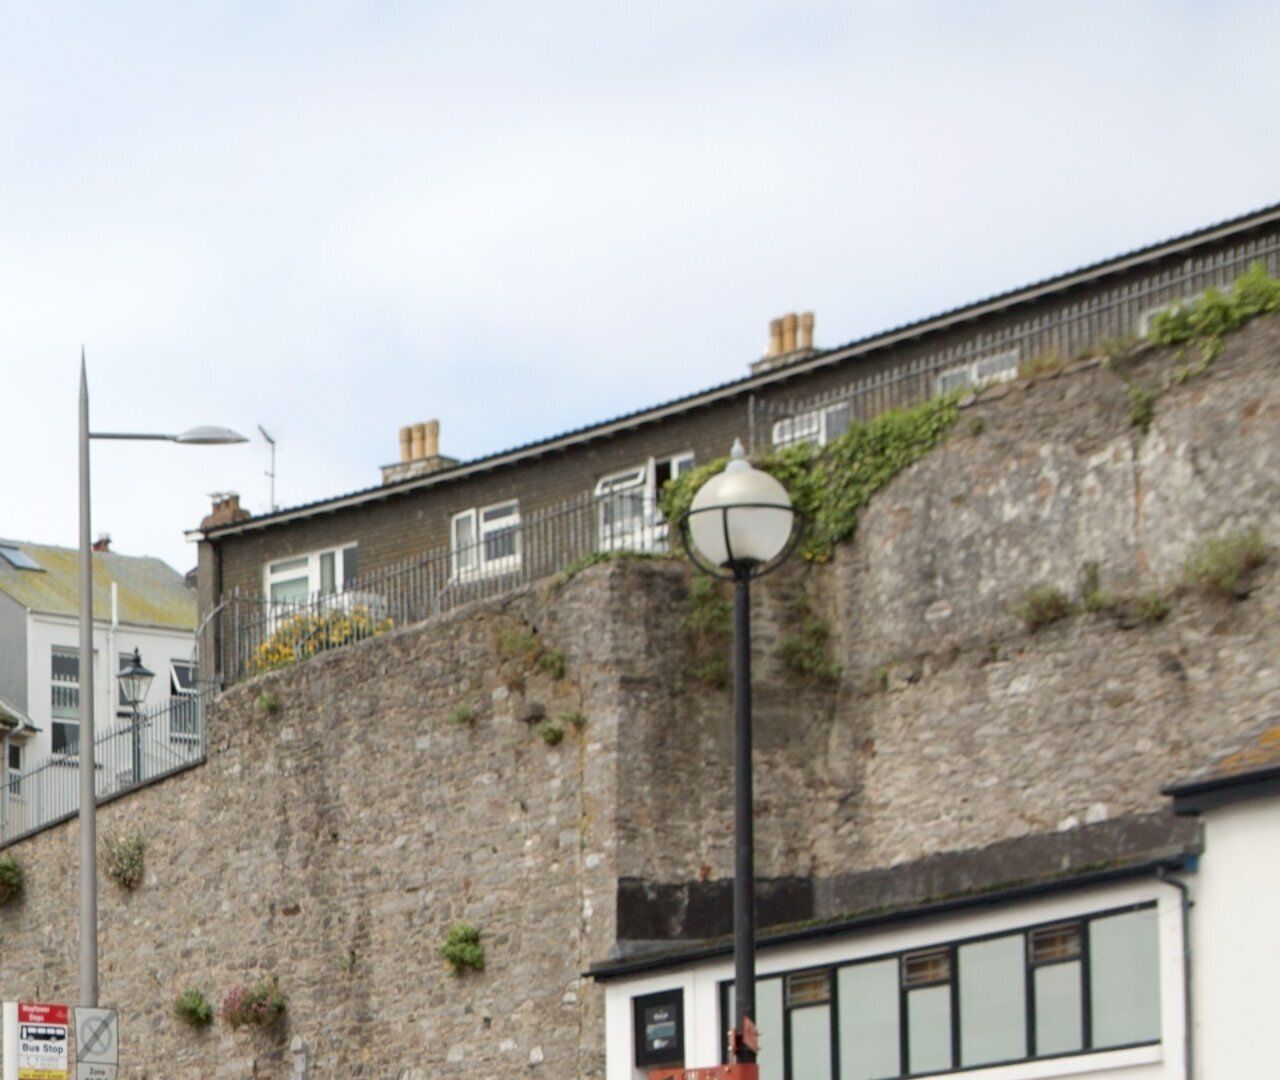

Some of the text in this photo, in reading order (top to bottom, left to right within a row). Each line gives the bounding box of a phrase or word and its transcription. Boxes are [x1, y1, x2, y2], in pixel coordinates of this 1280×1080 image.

[22, 1043, 64, 1054] Bus Stop
[89, 1067, 106, 1076] Zone
